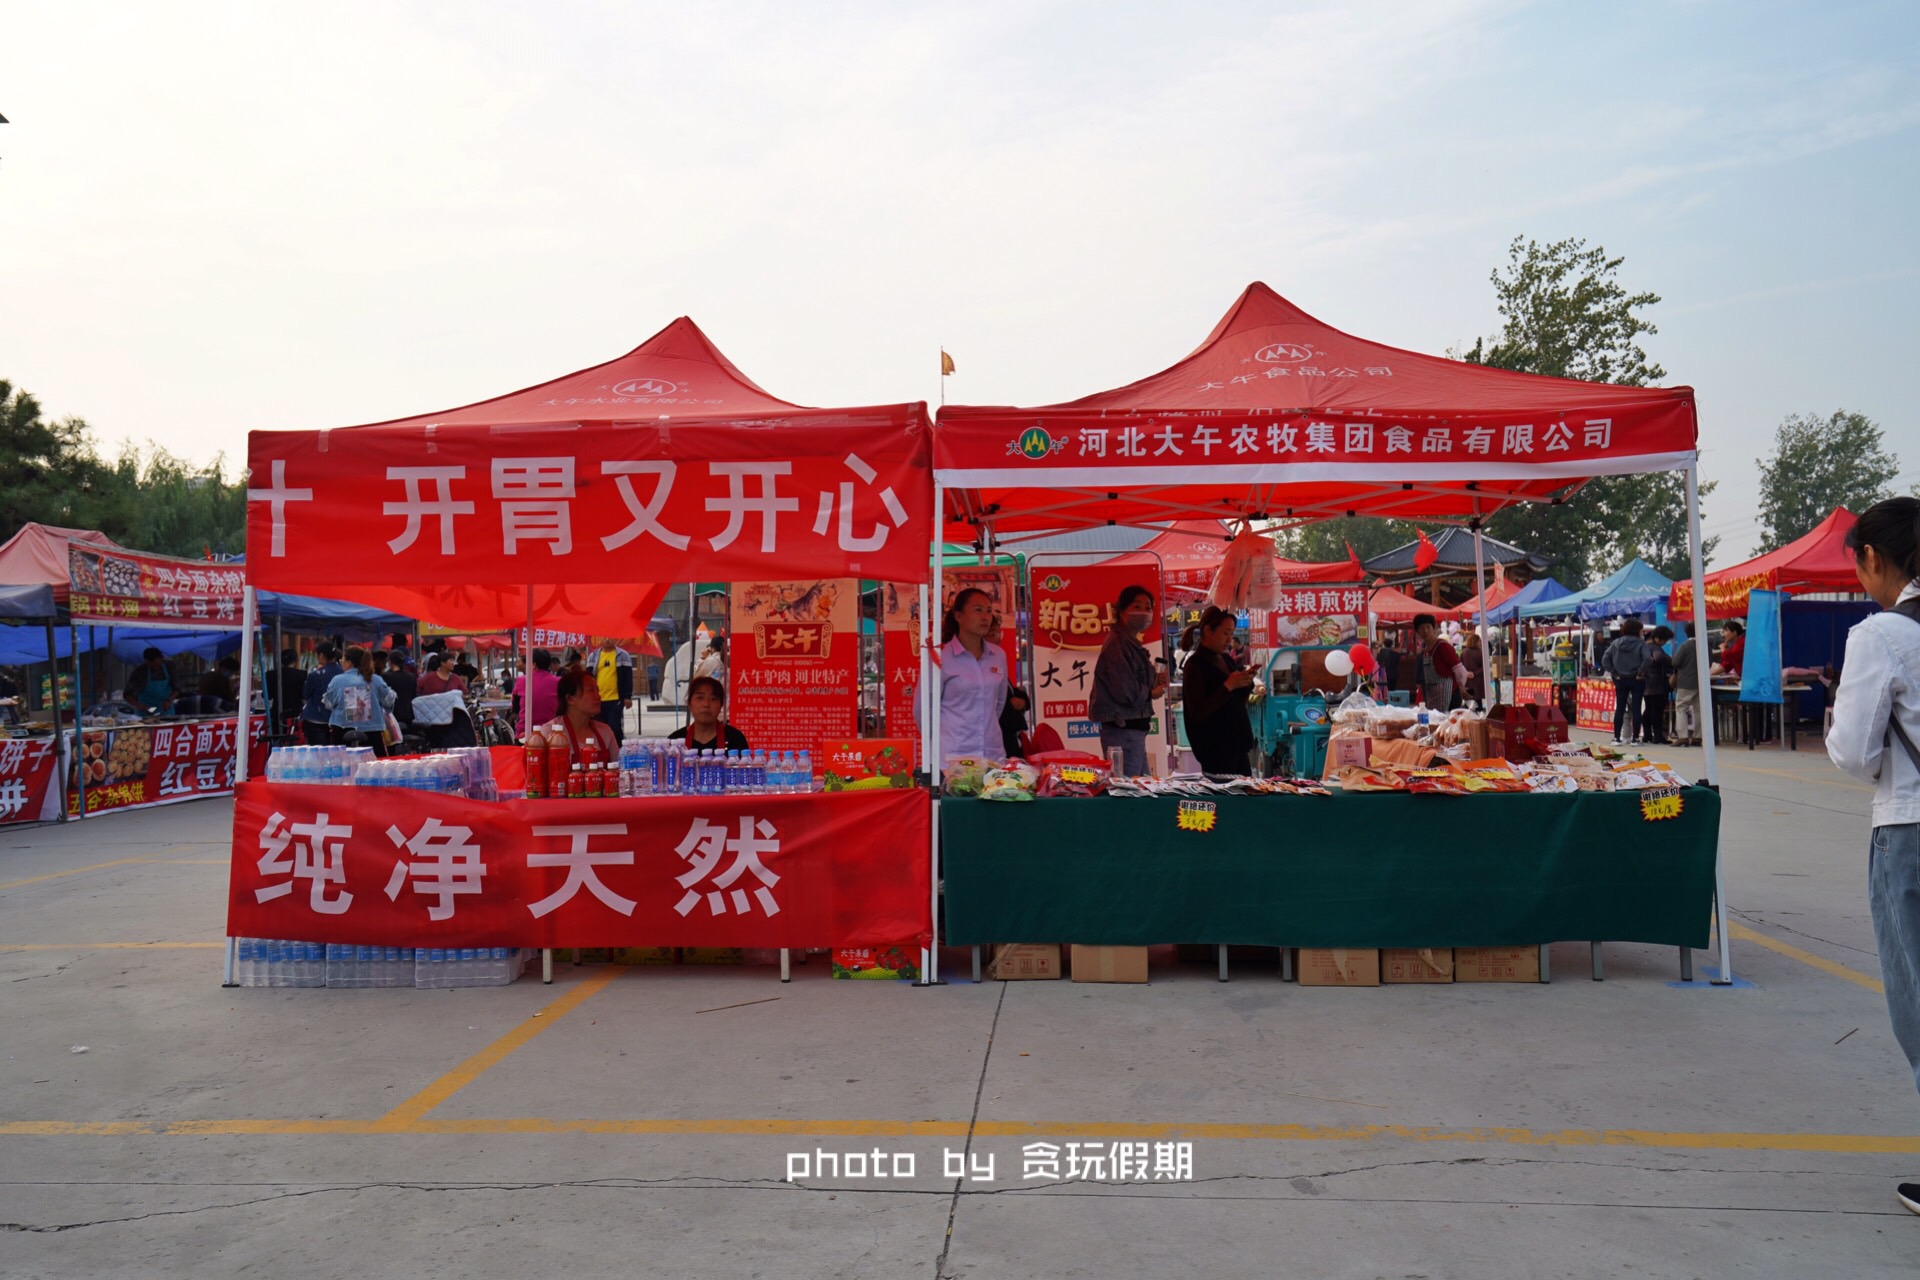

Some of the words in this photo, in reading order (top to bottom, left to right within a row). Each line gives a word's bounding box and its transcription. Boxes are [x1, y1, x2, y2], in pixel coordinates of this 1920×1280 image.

[1196, 365, 1394, 392] 大午食品公司
[1078, 418, 1612, 458] 河北大午农牧集团食品有限公司
[162, 593, 258, 621] 红豆烤
[1272, 590, 1365, 615] 杂粮煎饼
[768, 627, 819, 653] 大午
[737, 669, 791, 685] 大午驴肉
[795, 669, 849, 685] 河北特产
[1040, 659, 1090, 691] 大午
[1068, 723, 1102, 736] 慢火卤
[68, 781, 145, 814] 五谷杂粮饼
[254, 811, 782, 922] 纯净天然
